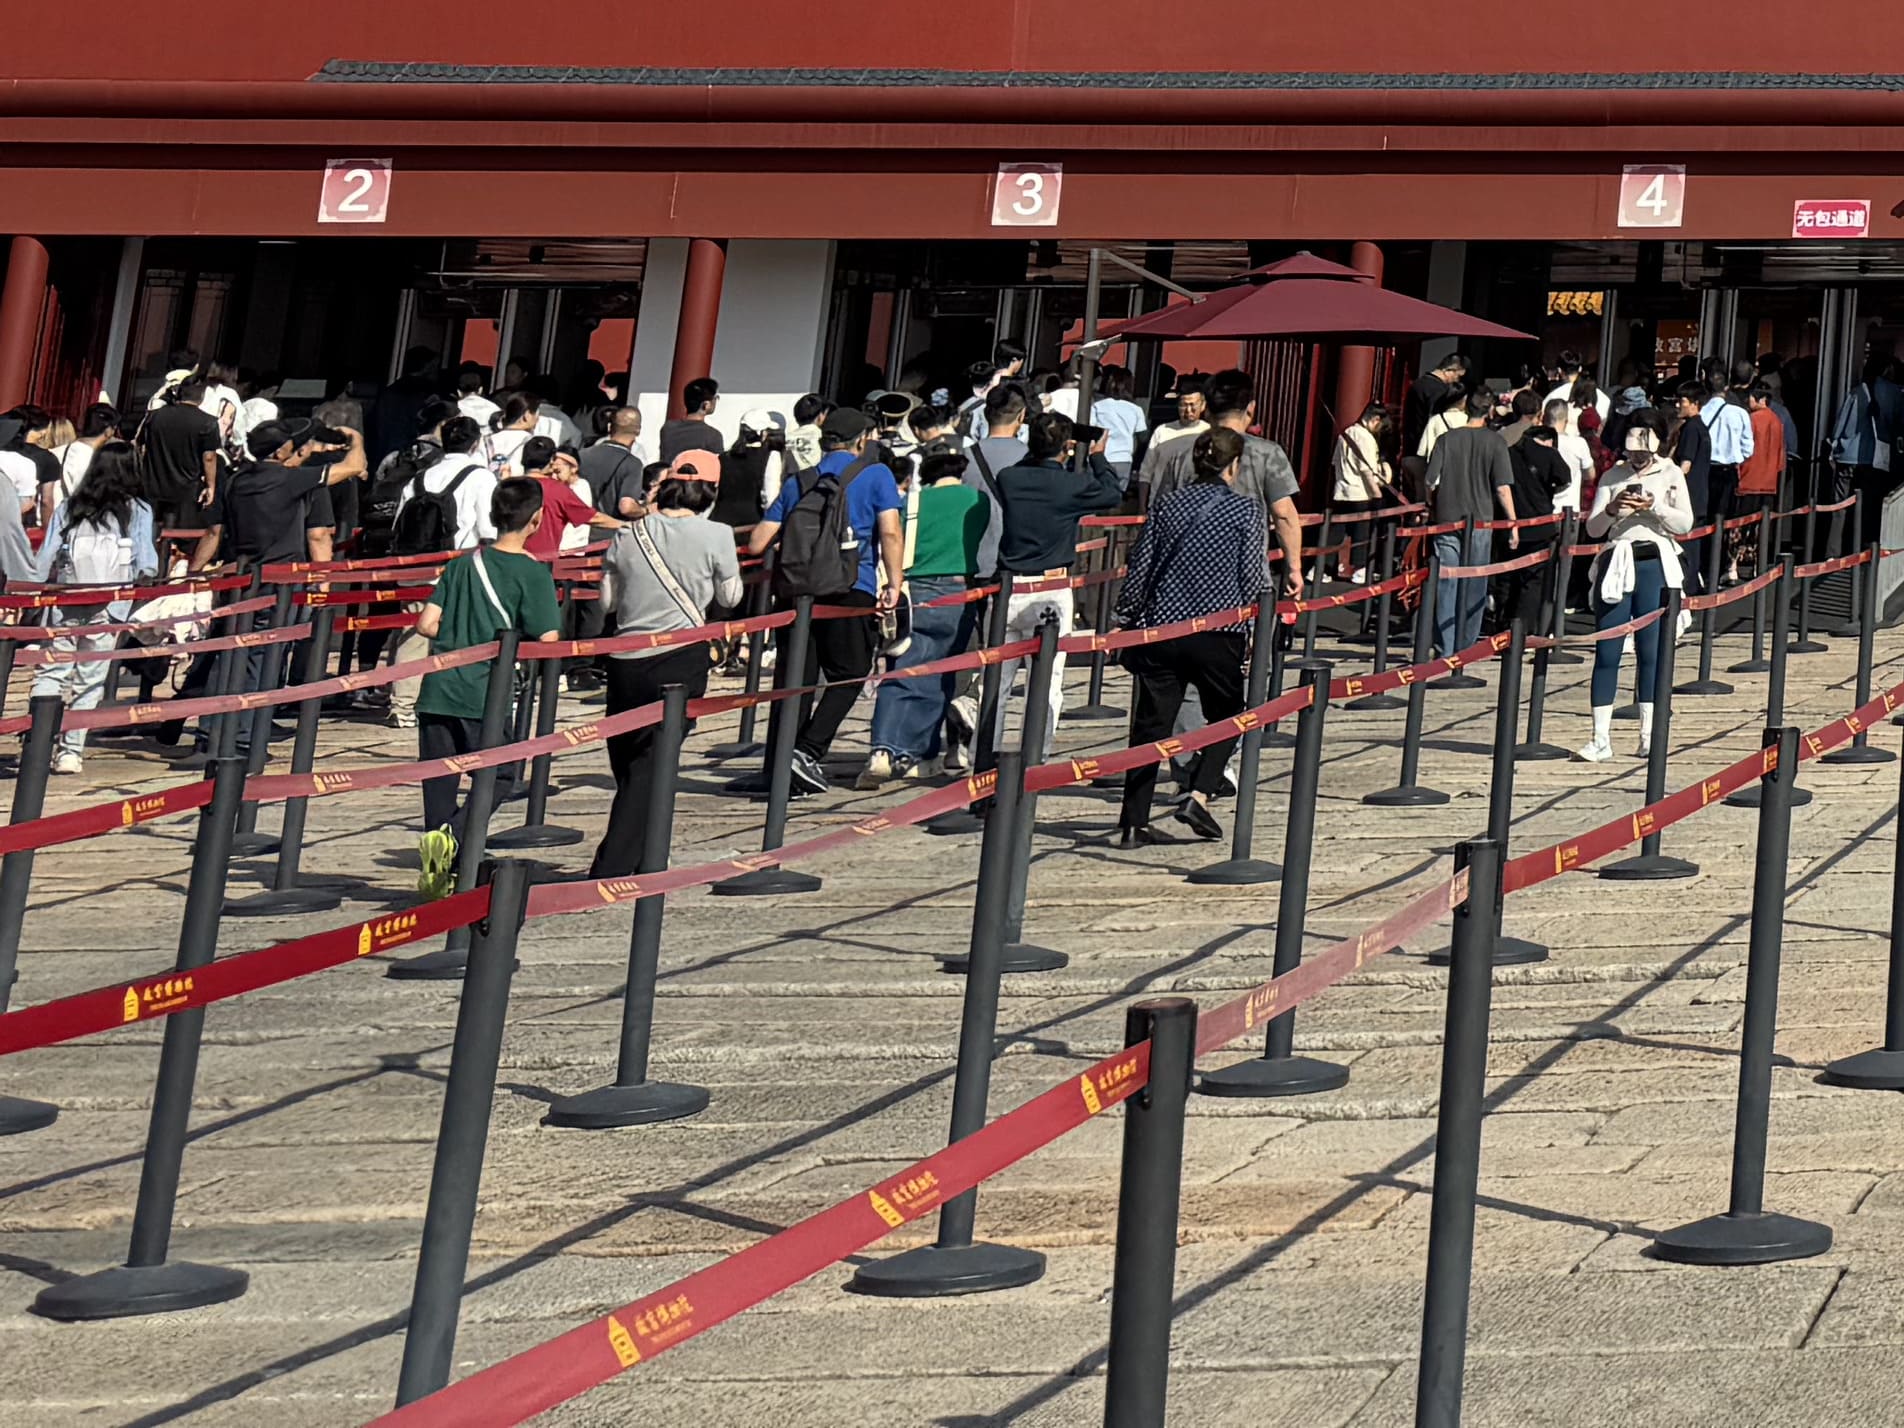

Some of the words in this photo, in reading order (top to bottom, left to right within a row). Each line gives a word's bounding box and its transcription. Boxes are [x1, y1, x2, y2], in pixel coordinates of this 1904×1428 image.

[338, 169, 372, 211] 2
[1013, 173, 1042, 215] 3
[1636, 174, 1667, 216] 4
[1797, 209, 1866, 227] 无包通道
